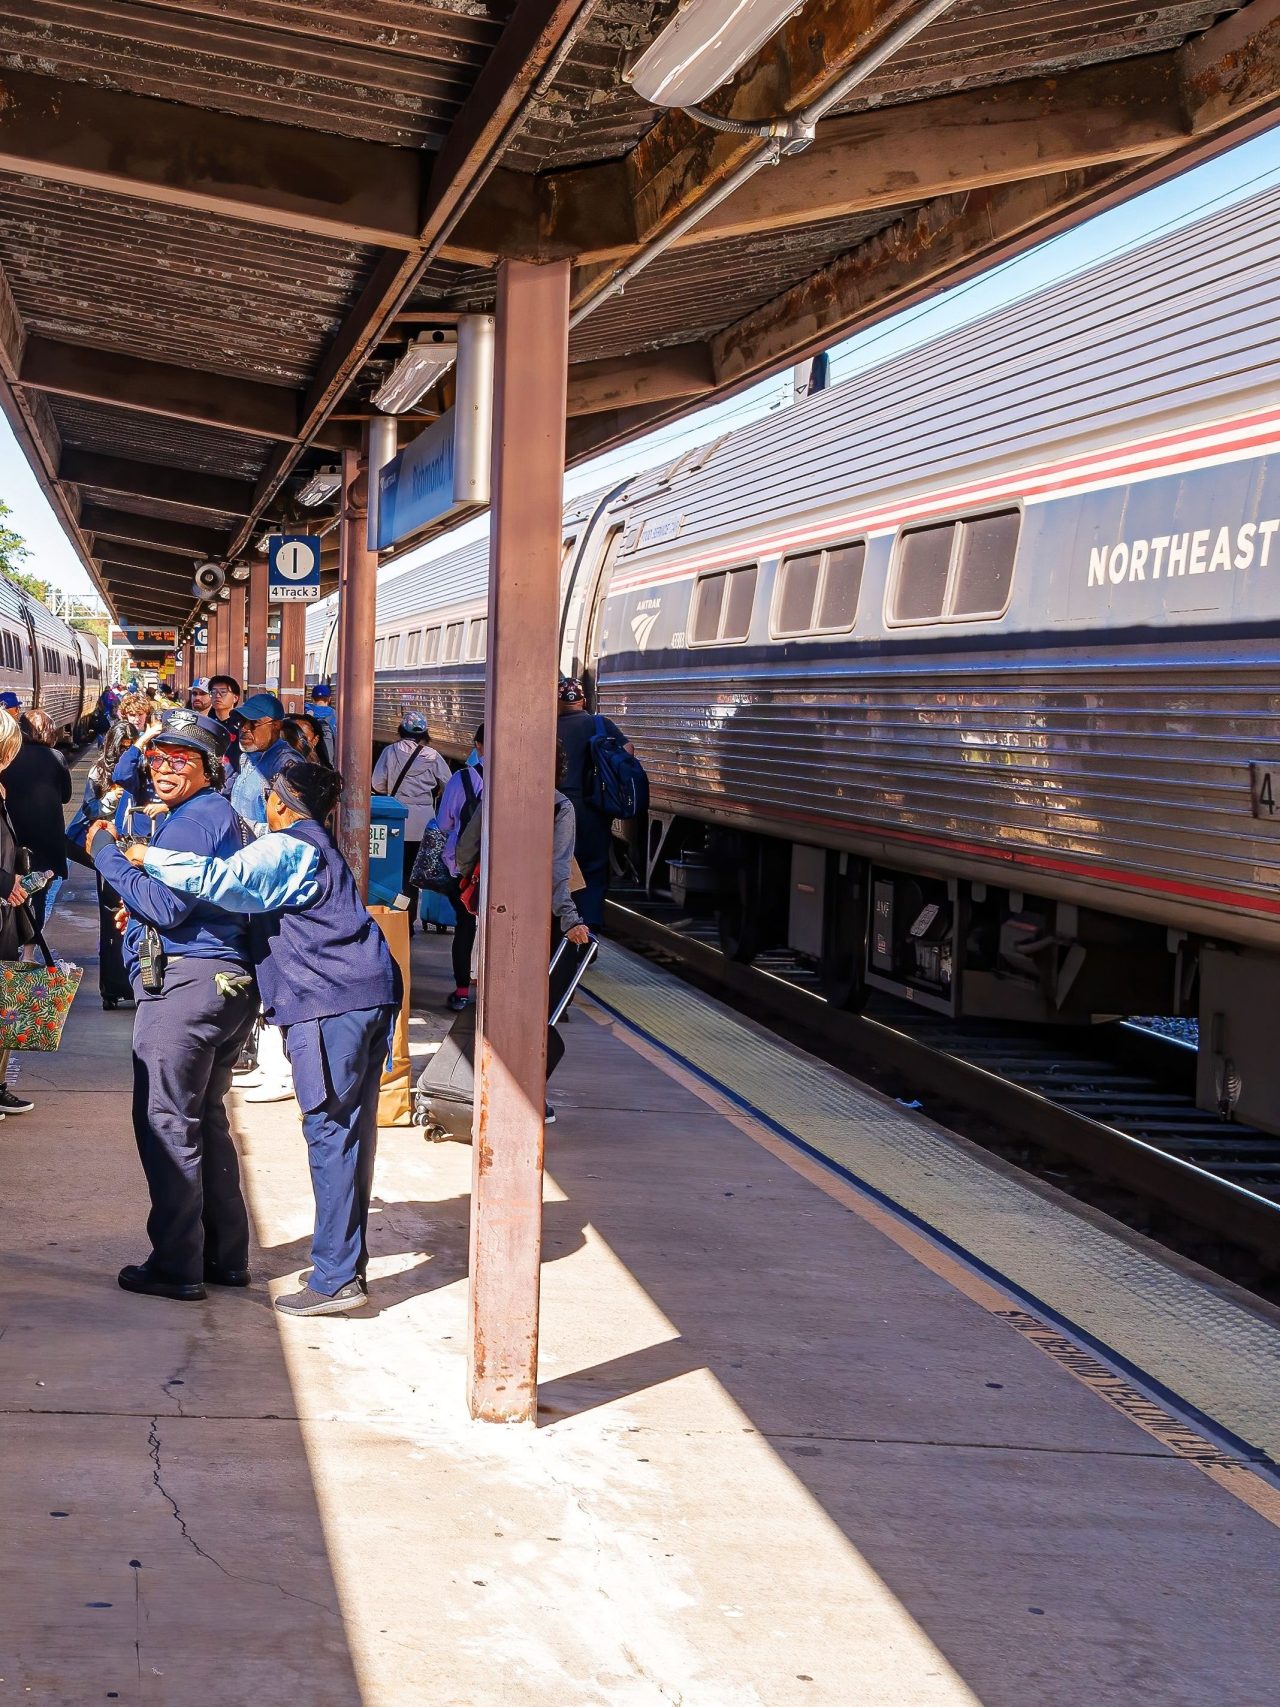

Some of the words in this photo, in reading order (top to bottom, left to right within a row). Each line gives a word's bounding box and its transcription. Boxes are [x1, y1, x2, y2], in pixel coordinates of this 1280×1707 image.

[1087, 519, 1280, 587] NORTHEAST
[271, 587, 279, 597] 4
[280, 586, 309, 597] Track
[311, 586, 318, 597] 3
[1260, 773, 1275, 815] 4
